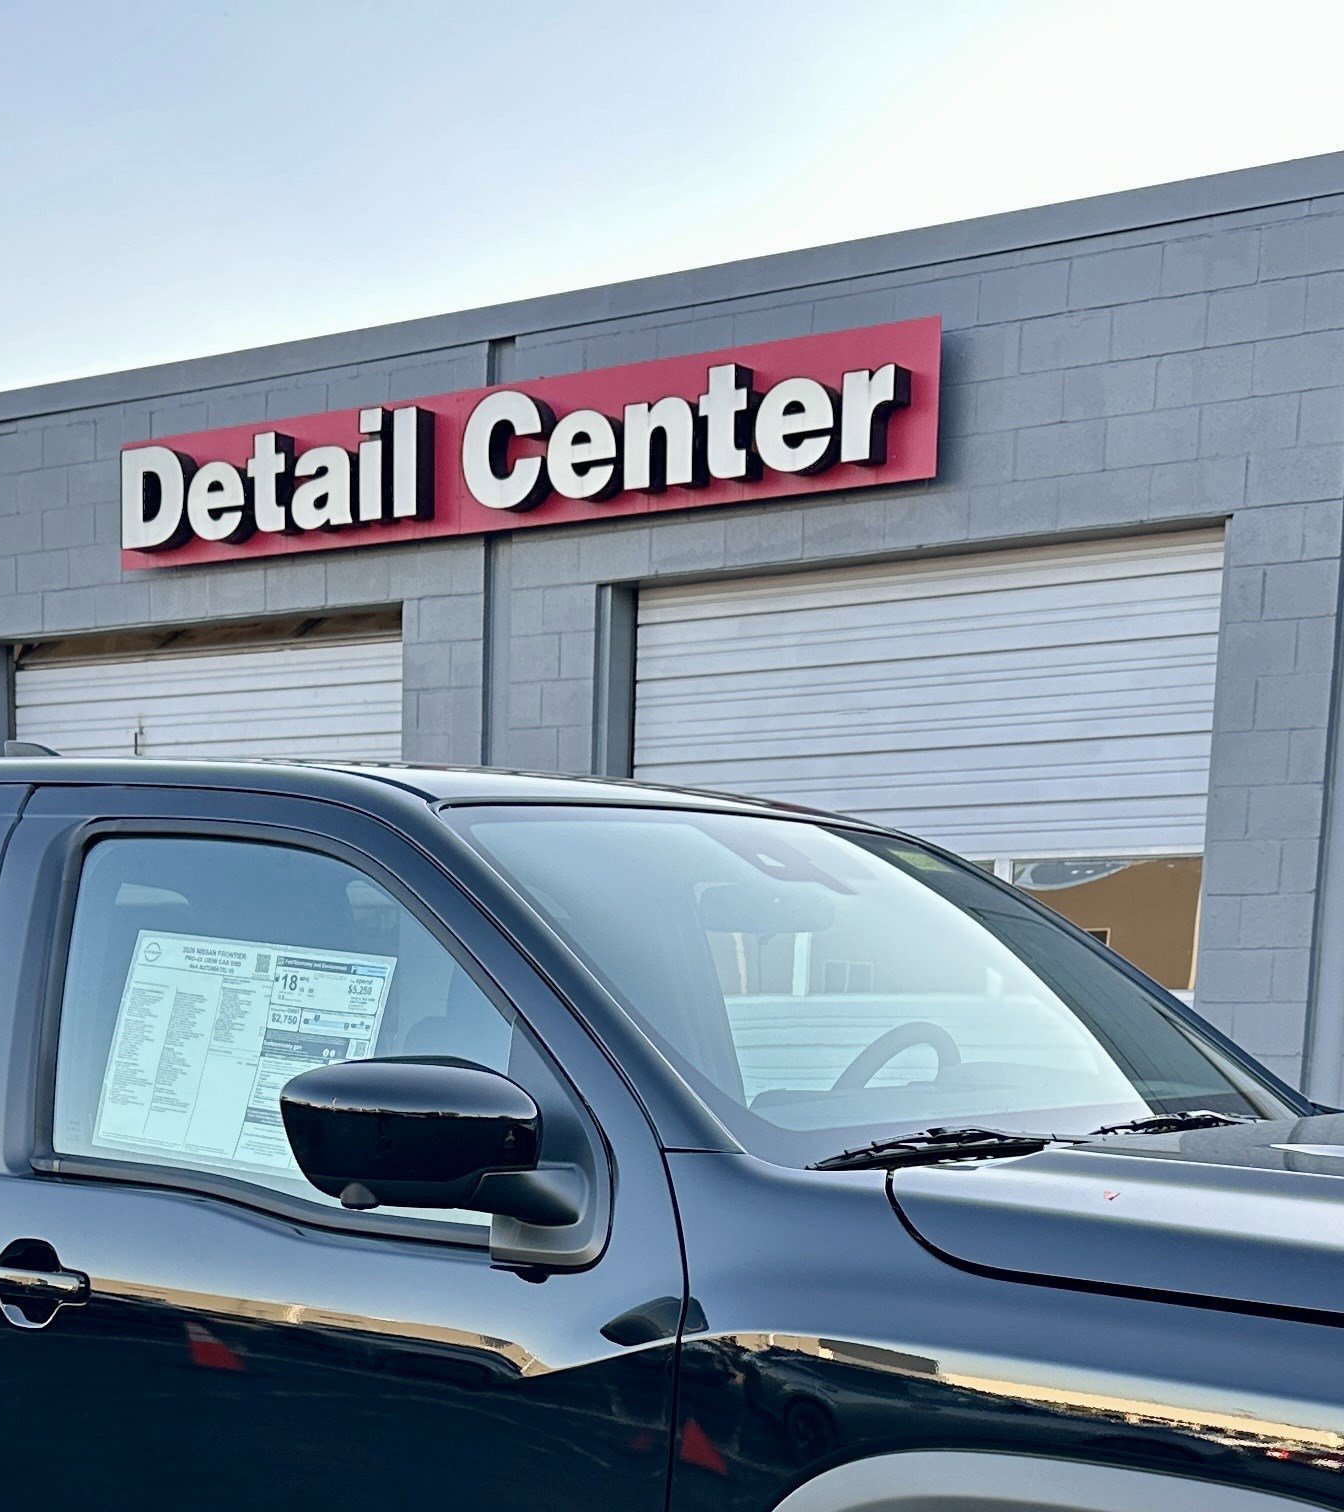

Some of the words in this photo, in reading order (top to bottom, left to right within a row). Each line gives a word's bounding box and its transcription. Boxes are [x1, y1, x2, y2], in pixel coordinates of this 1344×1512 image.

[121, 406, 420, 550] Detail
[462, 363, 894, 510] Center
[282, 974, 298, 991] 18
[271, 1012, 297, 1025] $2,750
